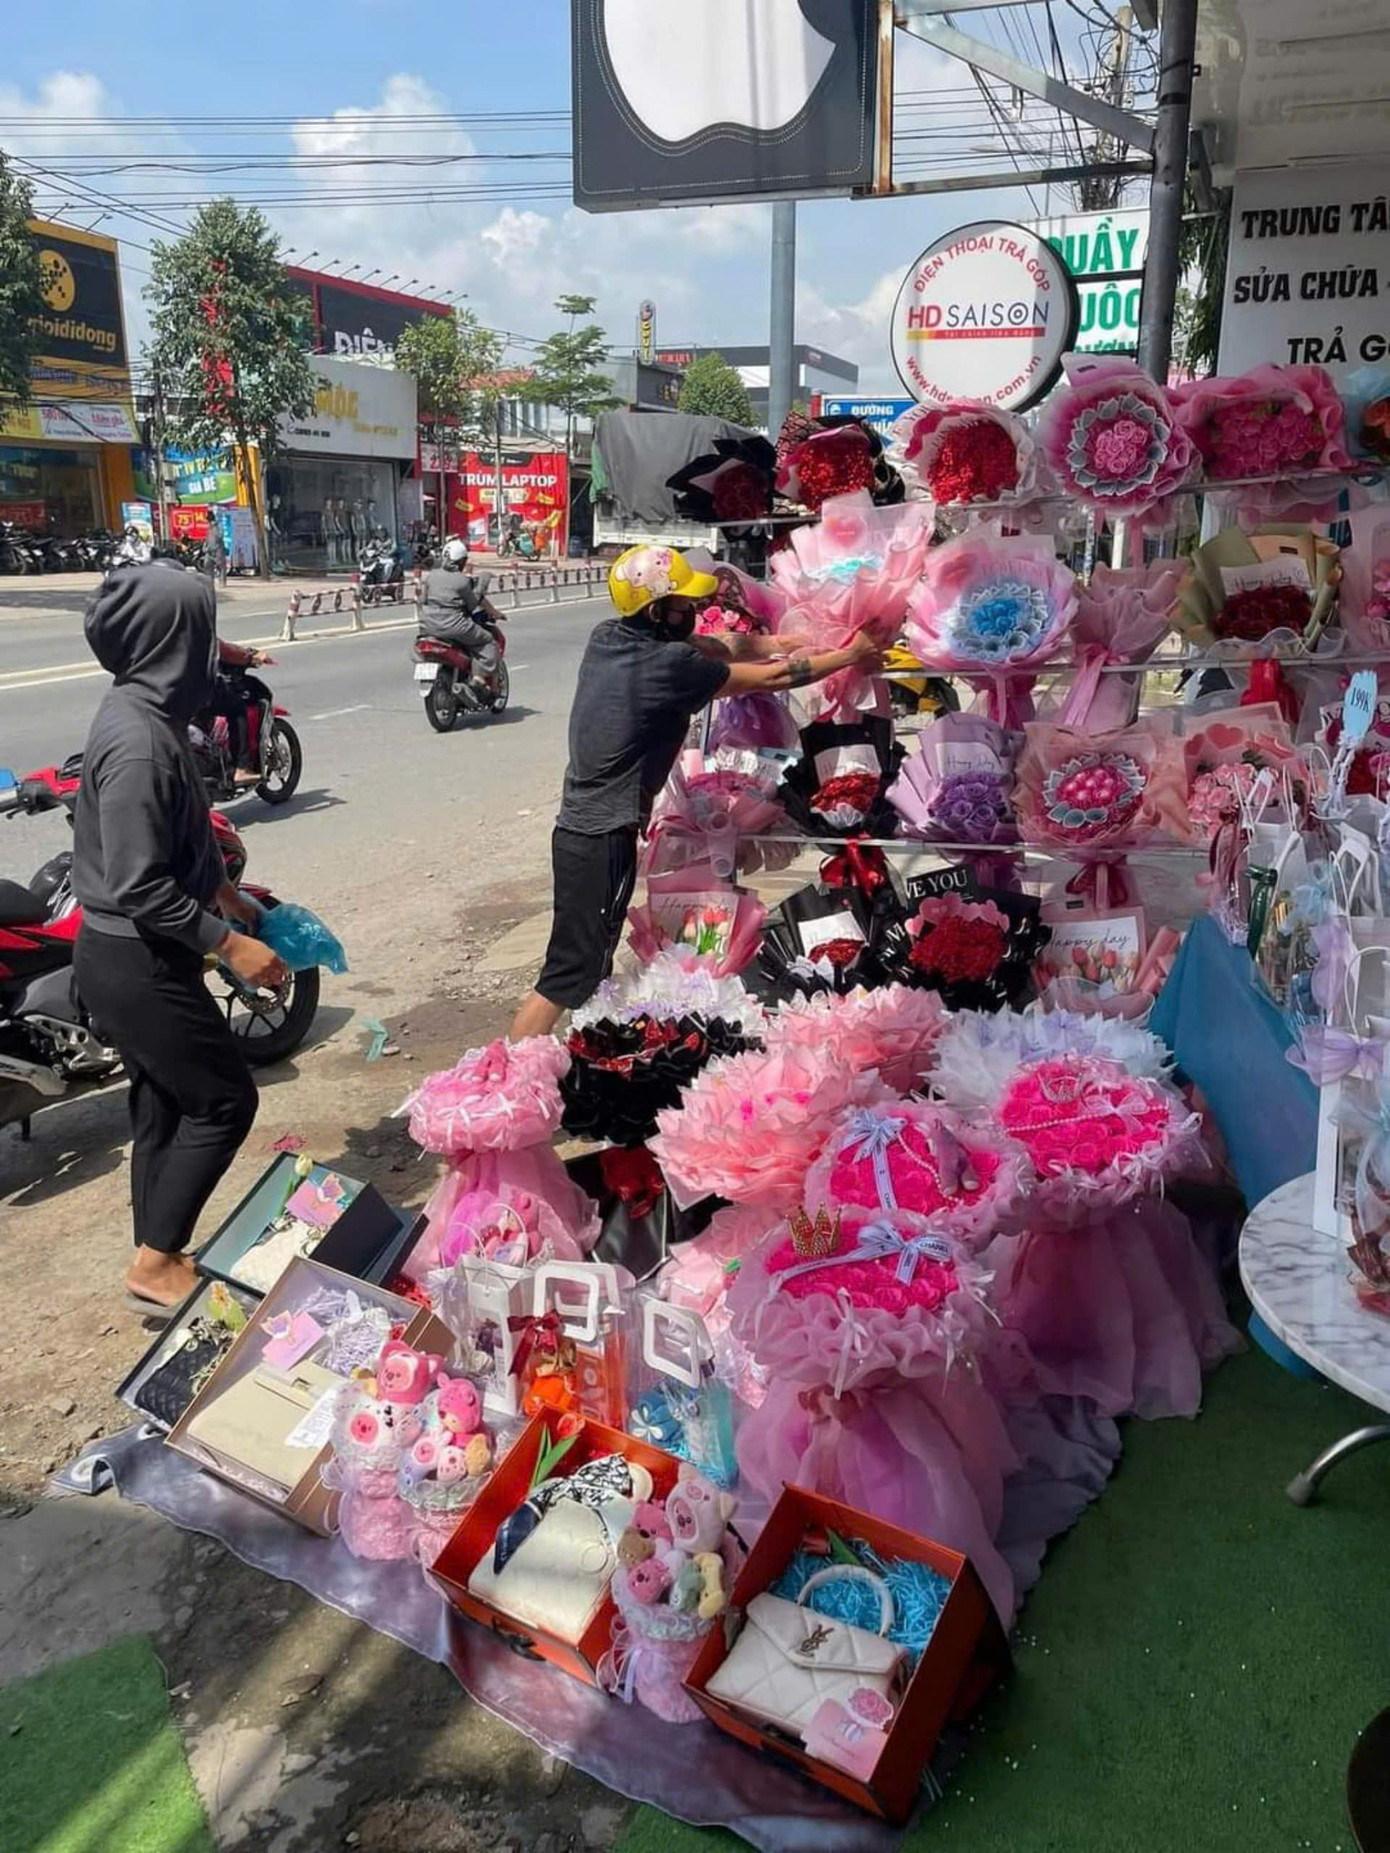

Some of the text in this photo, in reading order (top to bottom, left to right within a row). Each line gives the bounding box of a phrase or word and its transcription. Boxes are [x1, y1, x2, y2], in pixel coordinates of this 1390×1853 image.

[1241, 196, 1390, 239] TRUNG TÂ
[914, 236, 1050, 293] ĐIỆN THOẠI TRẢ GÓP
[1233, 264, 1378, 304] SỬA CHỮA
[908, 301, 1050, 328] HD SAISON
[1287, 326, 1390, 364] TRẢ G
[906, 356, 1042, 406] www.hdn.com.vn
[501, 474, 557, 486] LAPTOP
[927, 870, 969, 893] YOU
